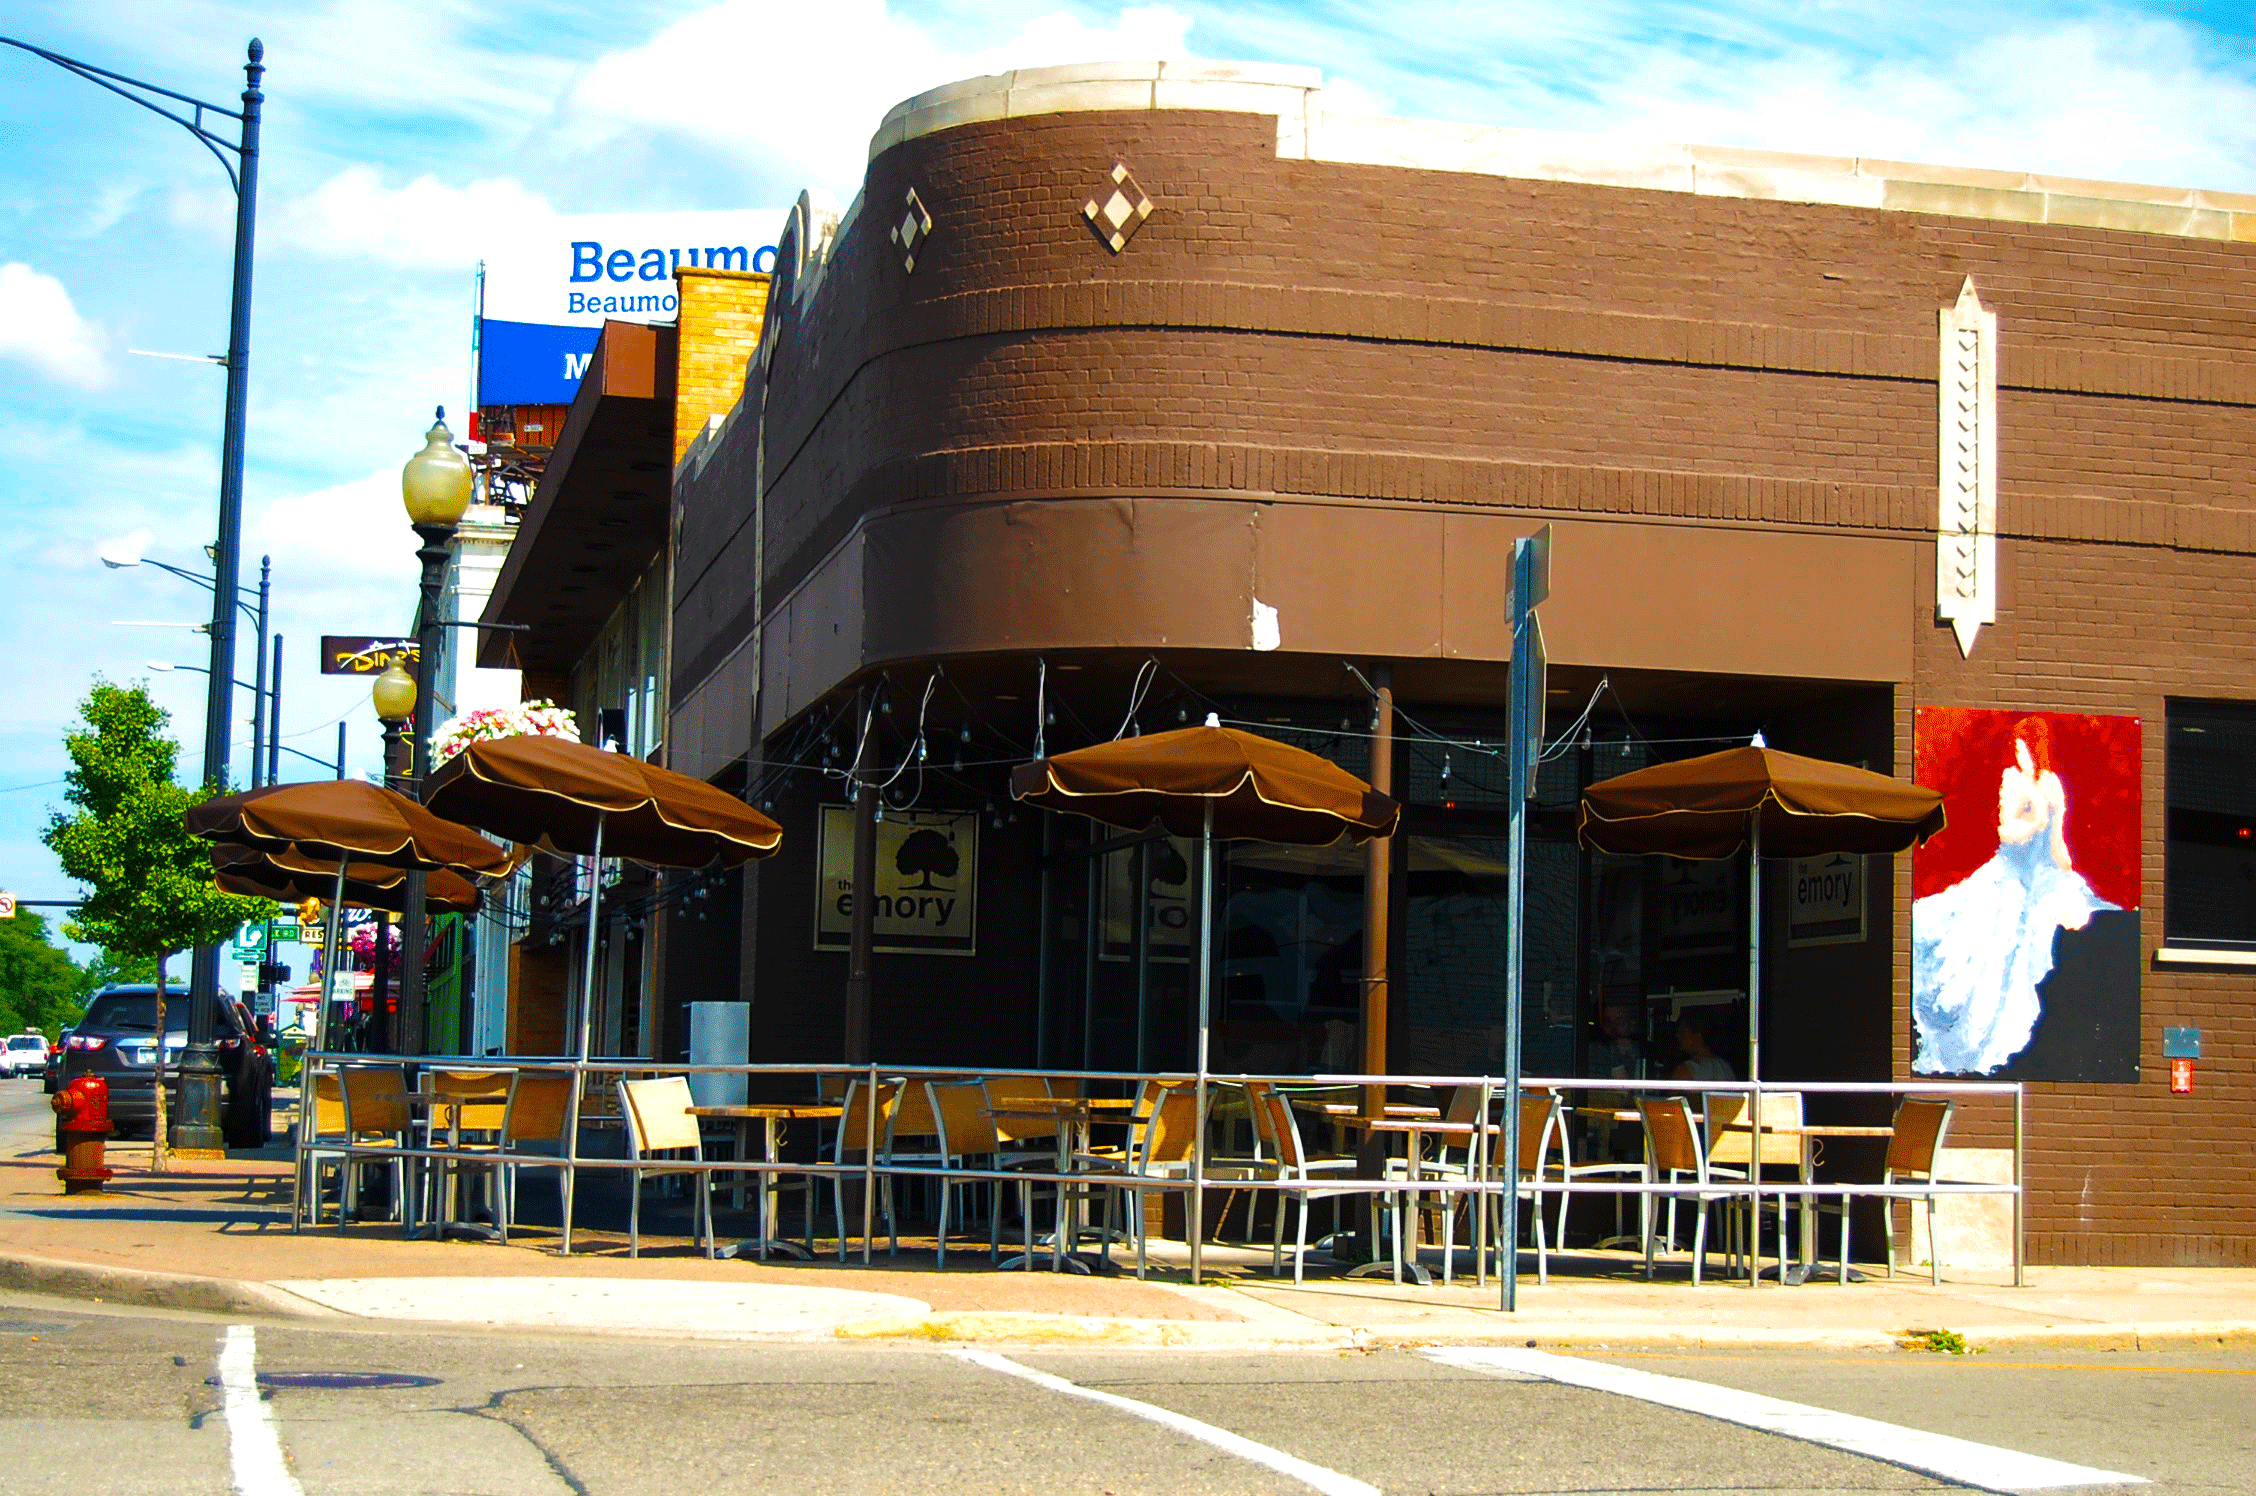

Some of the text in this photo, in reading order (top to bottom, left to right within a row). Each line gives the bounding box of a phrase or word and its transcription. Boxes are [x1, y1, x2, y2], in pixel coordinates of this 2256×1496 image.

[569, 241, 780, 283] Beaumo
[568, 292, 678, 314] Beaumo
[837, 879, 854, 891] th
[1798, 871, 1853, 907] emory
